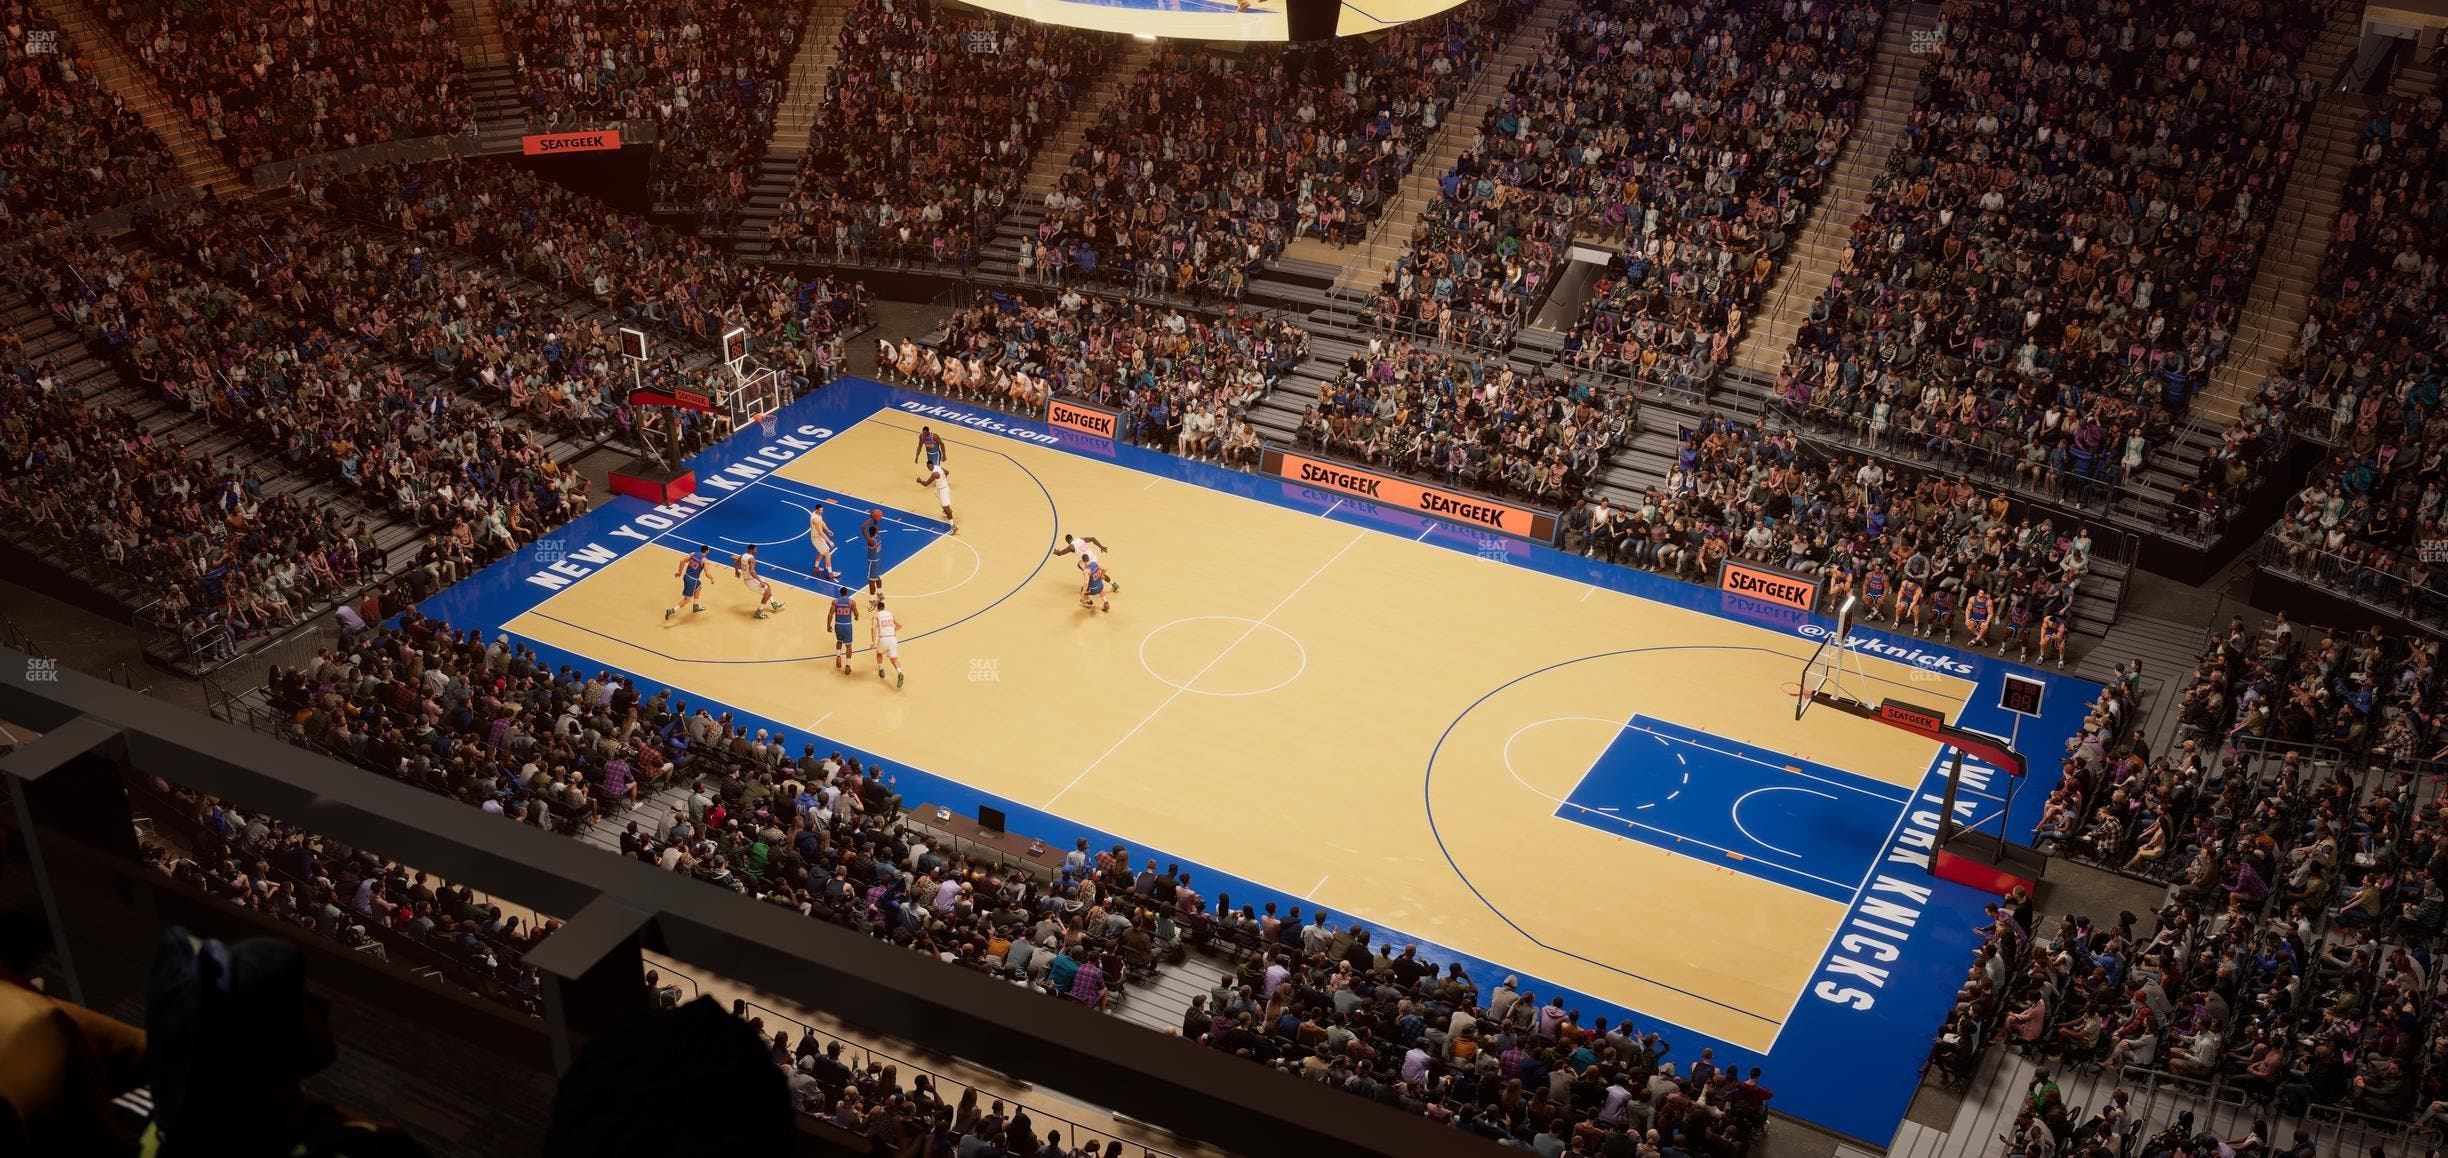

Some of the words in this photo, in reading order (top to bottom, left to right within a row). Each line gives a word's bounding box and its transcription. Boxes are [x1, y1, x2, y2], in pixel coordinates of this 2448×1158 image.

[540, 135, 605, 152] SEATGEEK
[900, 400, 1060, 445] nyknicks.com
[1053, 407, 1111, 435] SEATGEEK
[526, 542, 618, 591] NEW
[608, 493, 717, 541] YORK
[703, 424, 834, 491] KNICKS
[1300, 463, 1381, 498] SEATGEEK
[1420, 492, 1504, 528] SEATGEEK
[1729, 571, 1808, 606] SEATGEEK
[1888, 709, 1933, 728] SEATGEEK
[1814, 874, 1932, 1010] KNICKS
